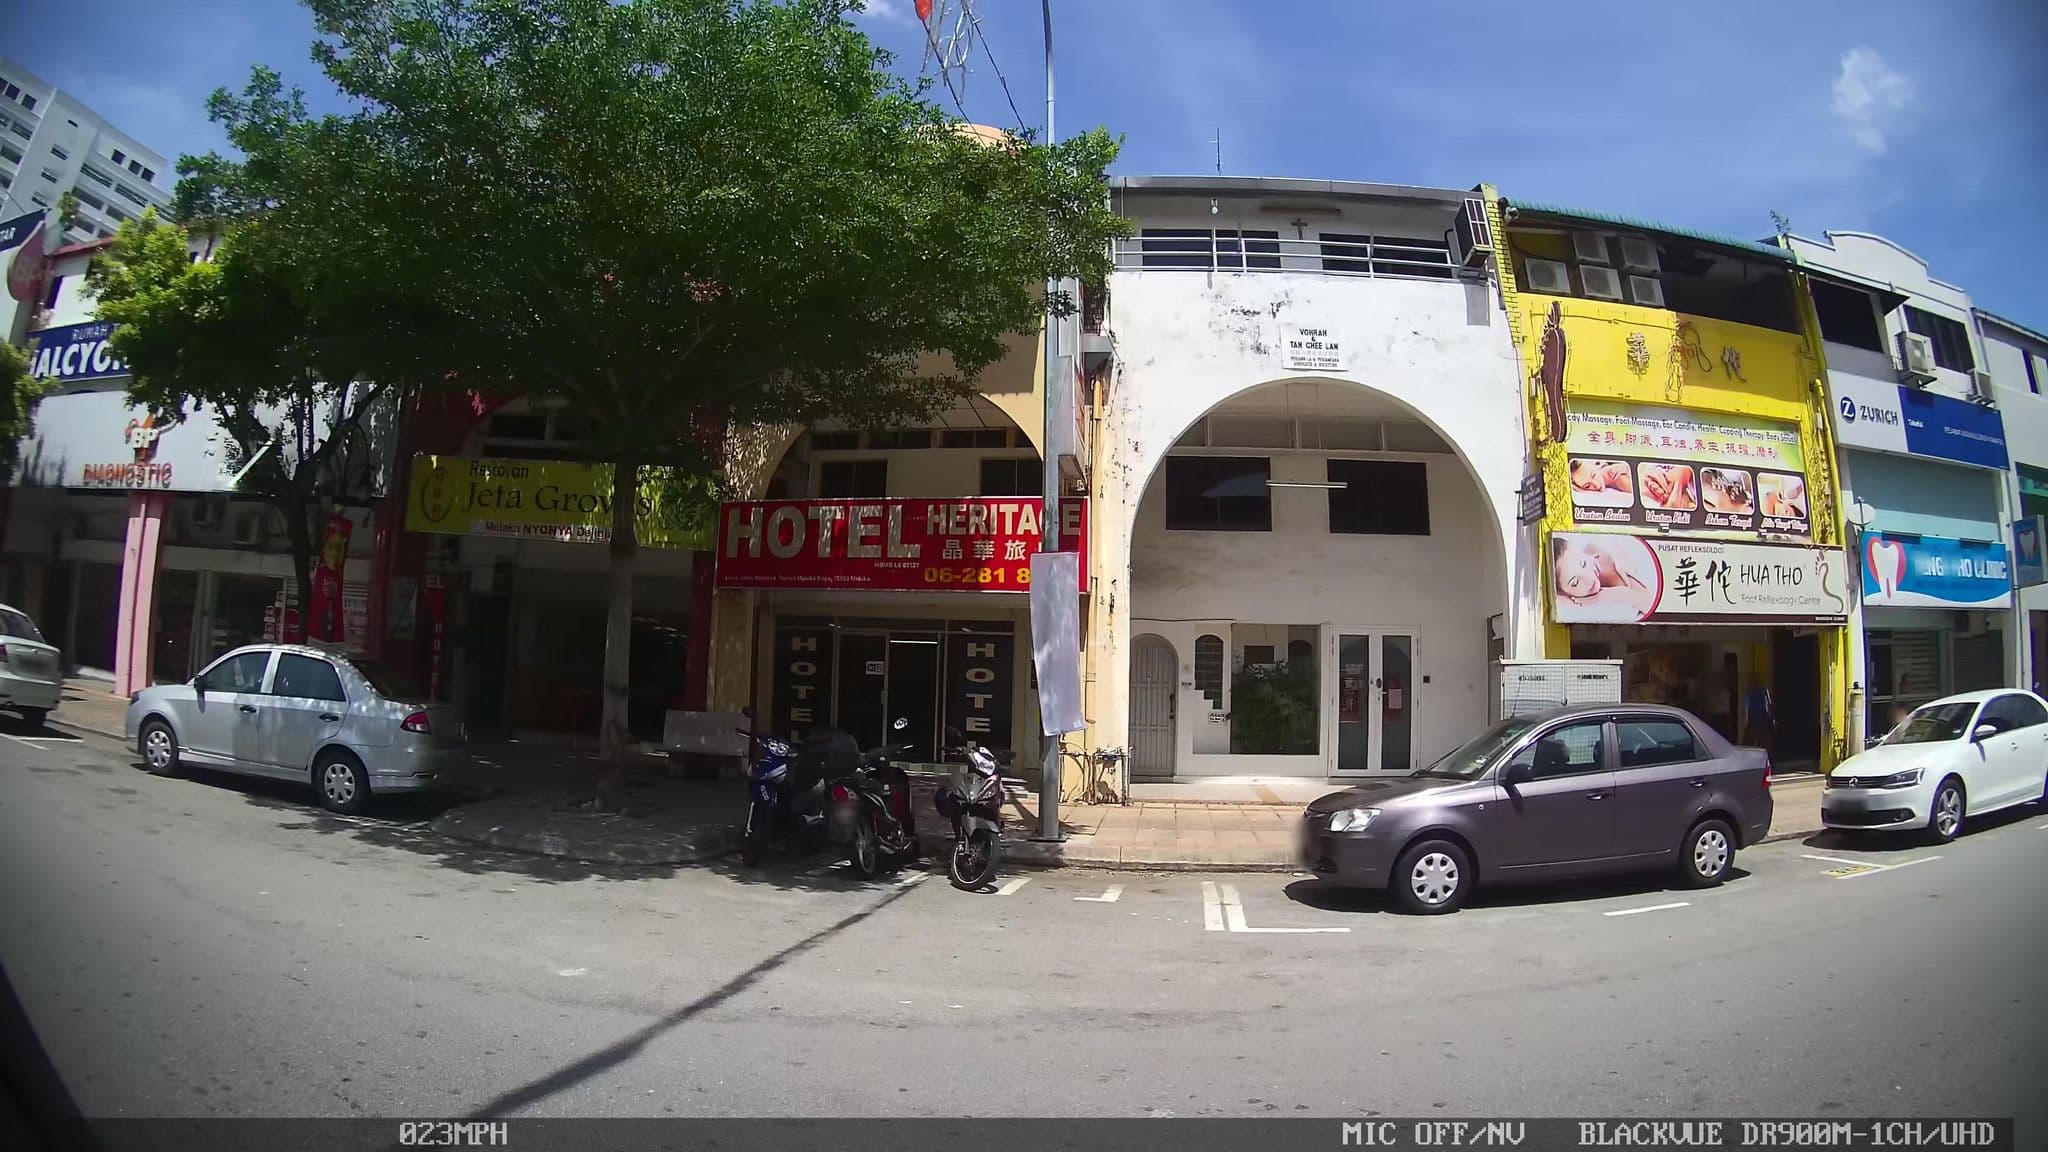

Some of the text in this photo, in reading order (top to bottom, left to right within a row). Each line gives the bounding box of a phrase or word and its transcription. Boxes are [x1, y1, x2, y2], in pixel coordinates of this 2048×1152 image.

[1300, 328, 1327, 337] VOHRAH
[1290, 341, 1339, 350] TAN CHEE LAN
[1859, 405, 1899, 426] ZURICH
[463, 482, 524, 514] Jeta
[535, 485, 651, 516] Grovs
[523, 523, 573, 537] NYONYA
[577, 526, 614, 543] Deligh
[726, 502, 1081, 559] HOTEL HERITAE
[943, 539, 1042, 561] 晶華旅
[1658, 544, 1678, 553] PUSAT
[924, 568, 1031, 584] 06-281 8
[1740, 563, 1803, 587] HUA THO
[1741, 593, 1757, 604] Foot
